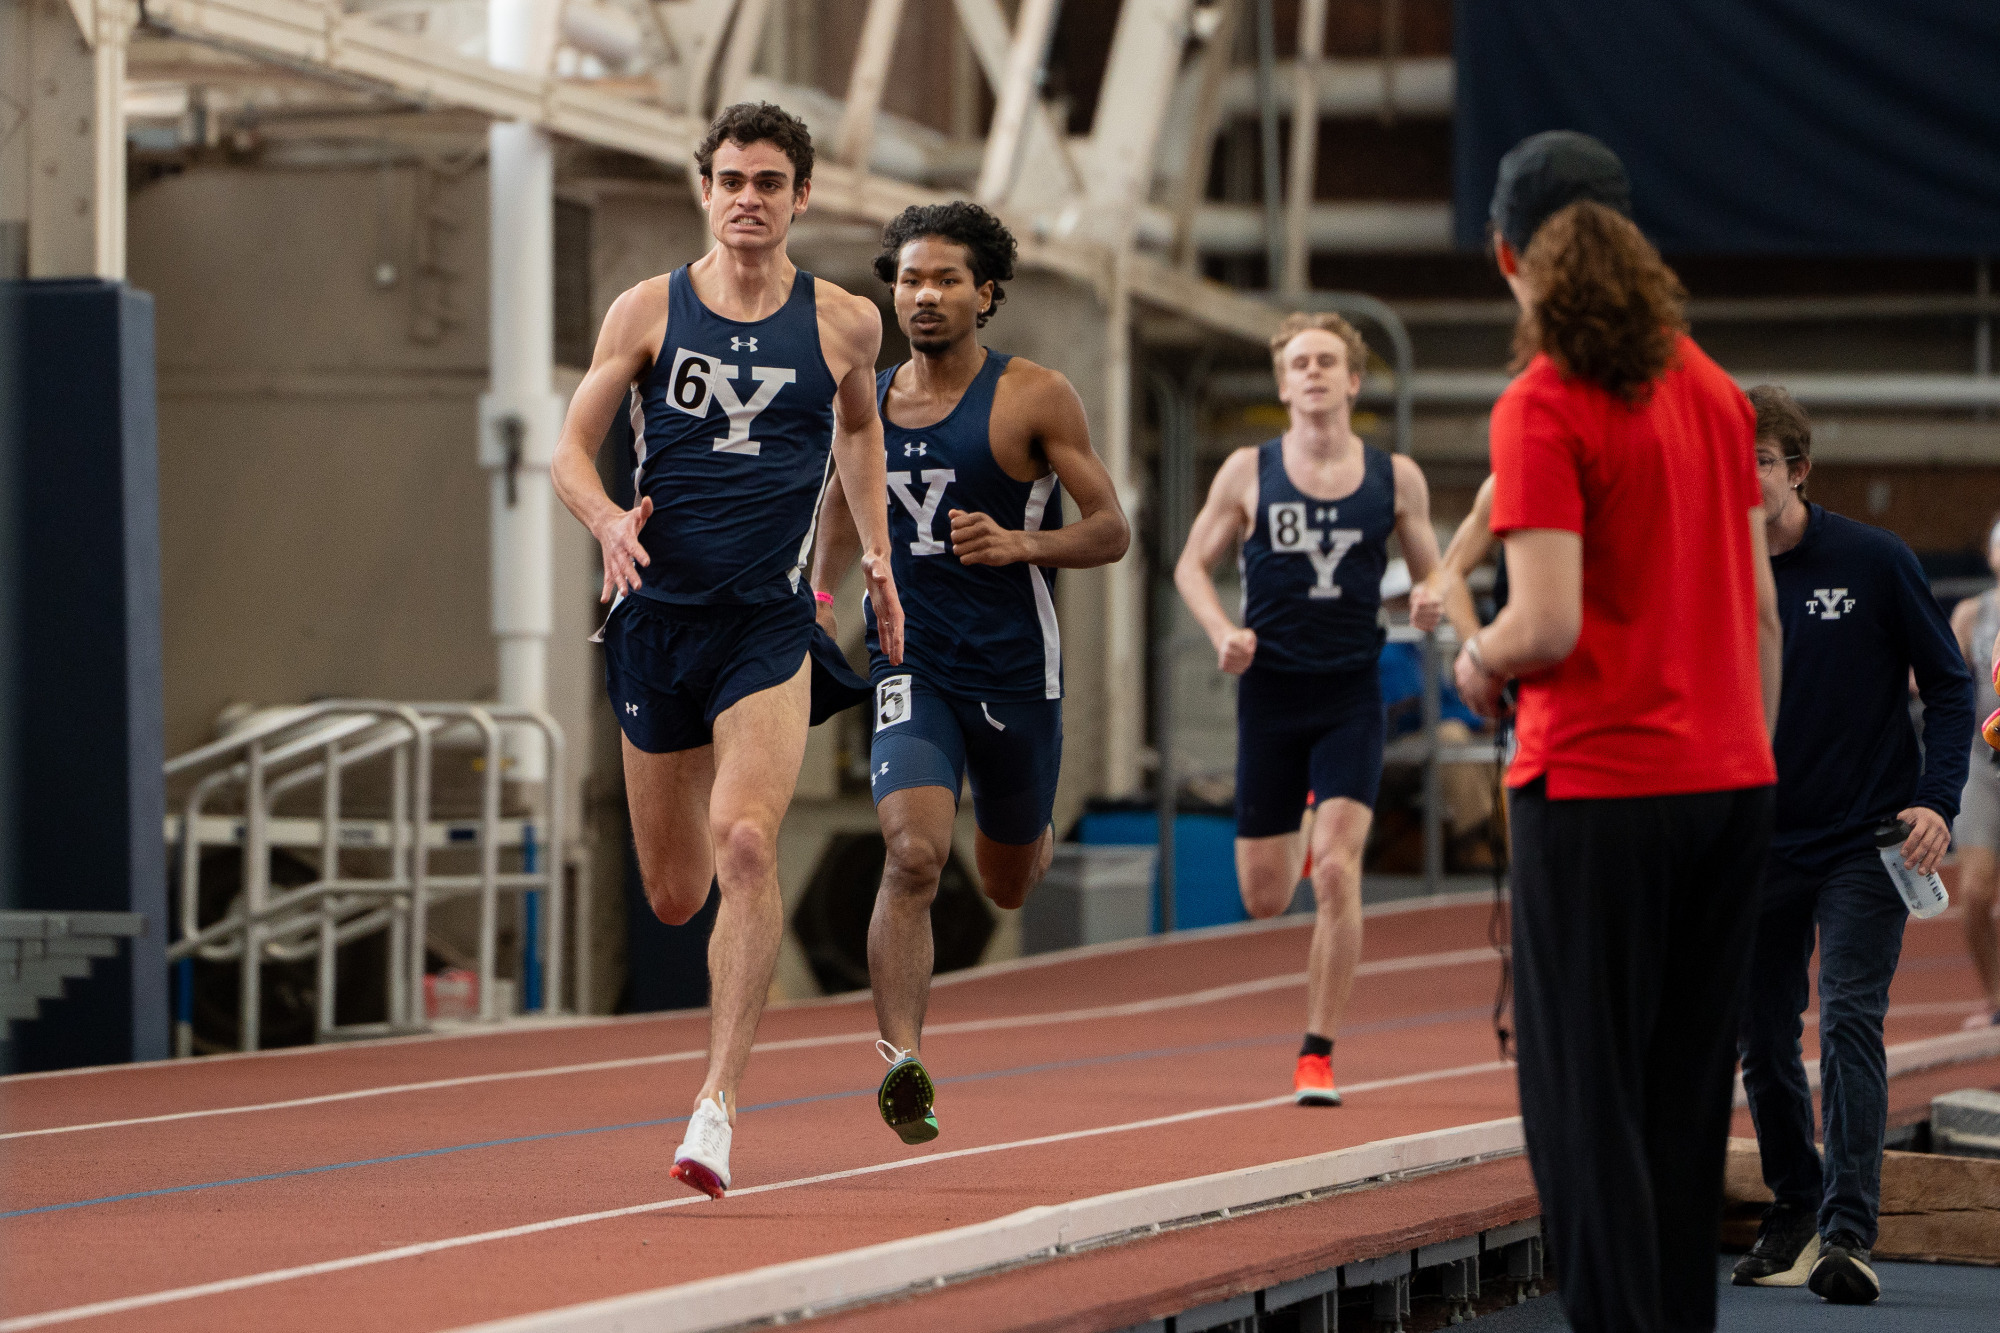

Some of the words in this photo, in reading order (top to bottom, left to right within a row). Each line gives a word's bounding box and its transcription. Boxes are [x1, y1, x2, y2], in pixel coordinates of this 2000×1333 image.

[674, 357, 710, 409] 6
[712, 364, 796, 456] Y
[886, 469, 956, 556] Y
[1277, 508, 1299, 547] 8
[1304, 529, 1363, 599] Y
[880, 678, 905, 725] 5
